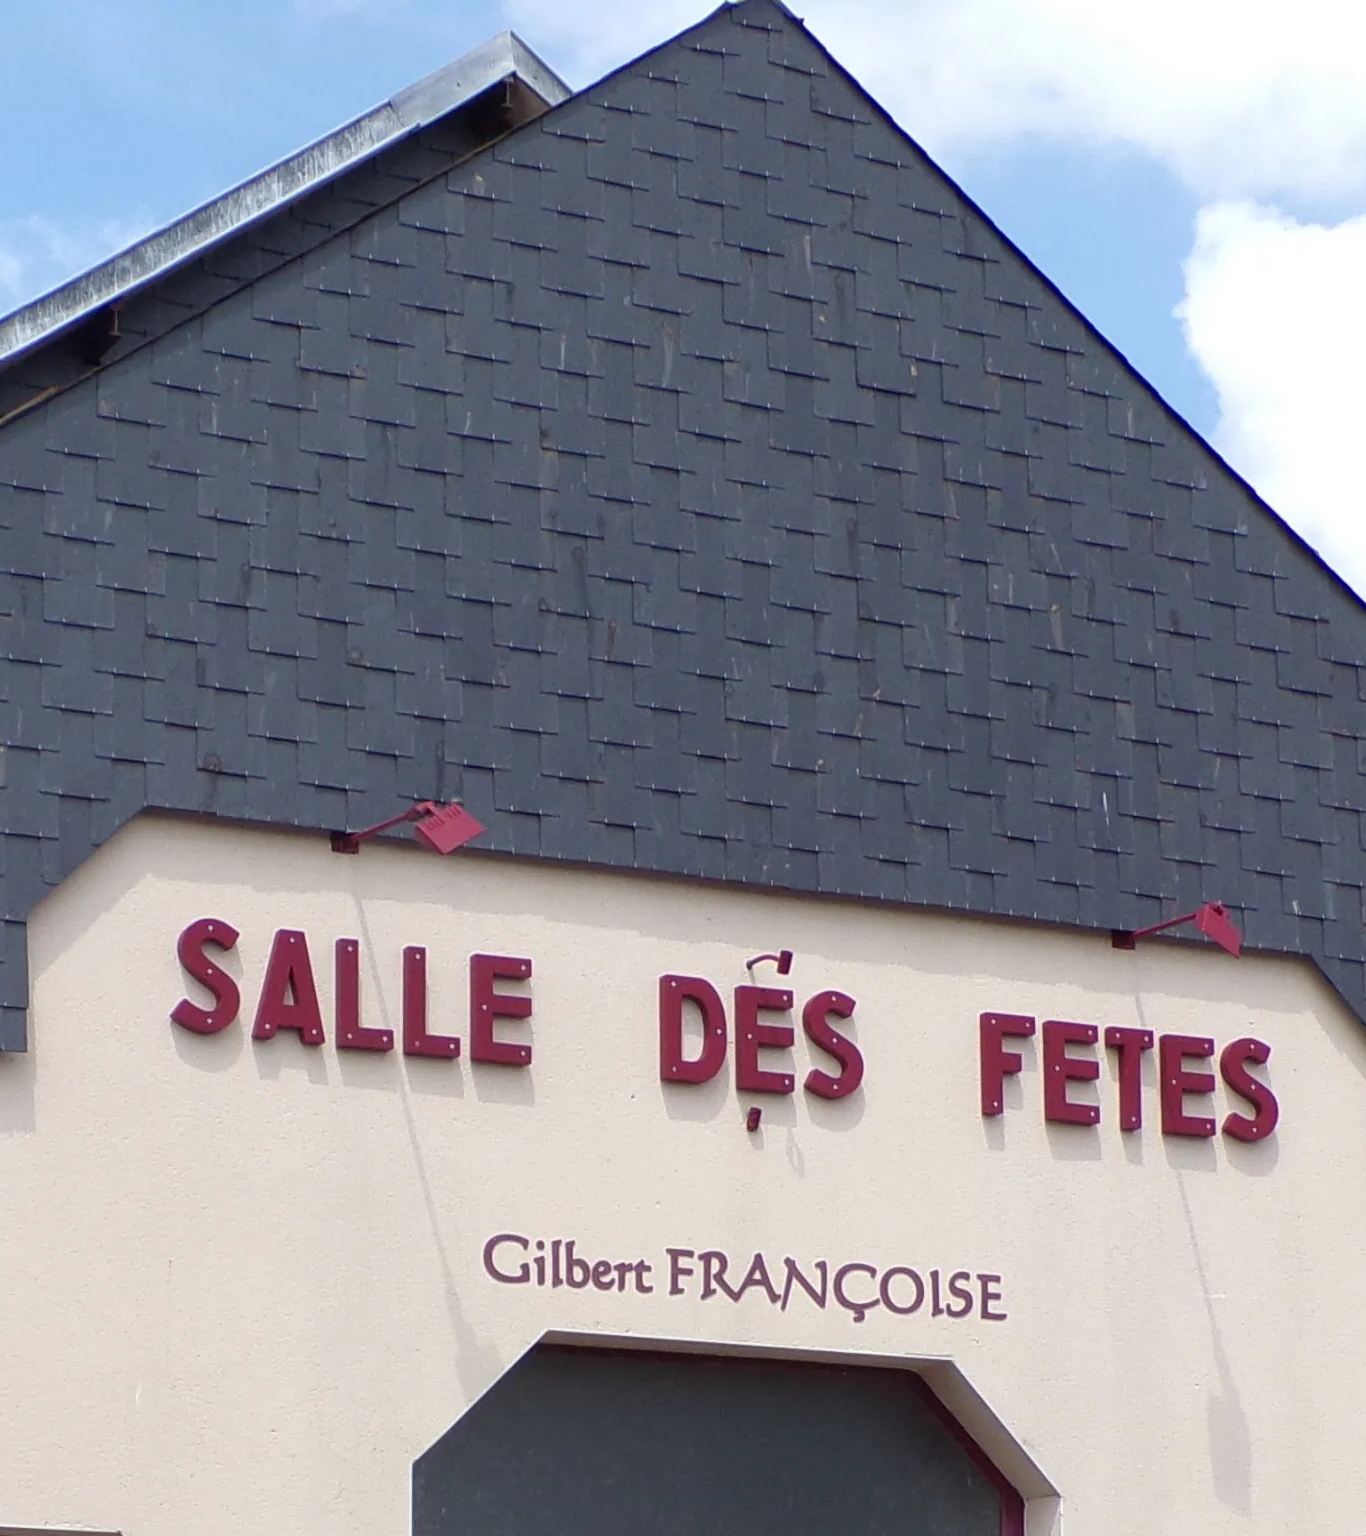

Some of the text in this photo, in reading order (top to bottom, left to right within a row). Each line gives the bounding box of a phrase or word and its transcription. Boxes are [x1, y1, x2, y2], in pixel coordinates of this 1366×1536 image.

[170, 917, 1280, 1143] SALLE DES FETES
[483, 1234, 1008, 1322] Gilbert FRANÇOISE
